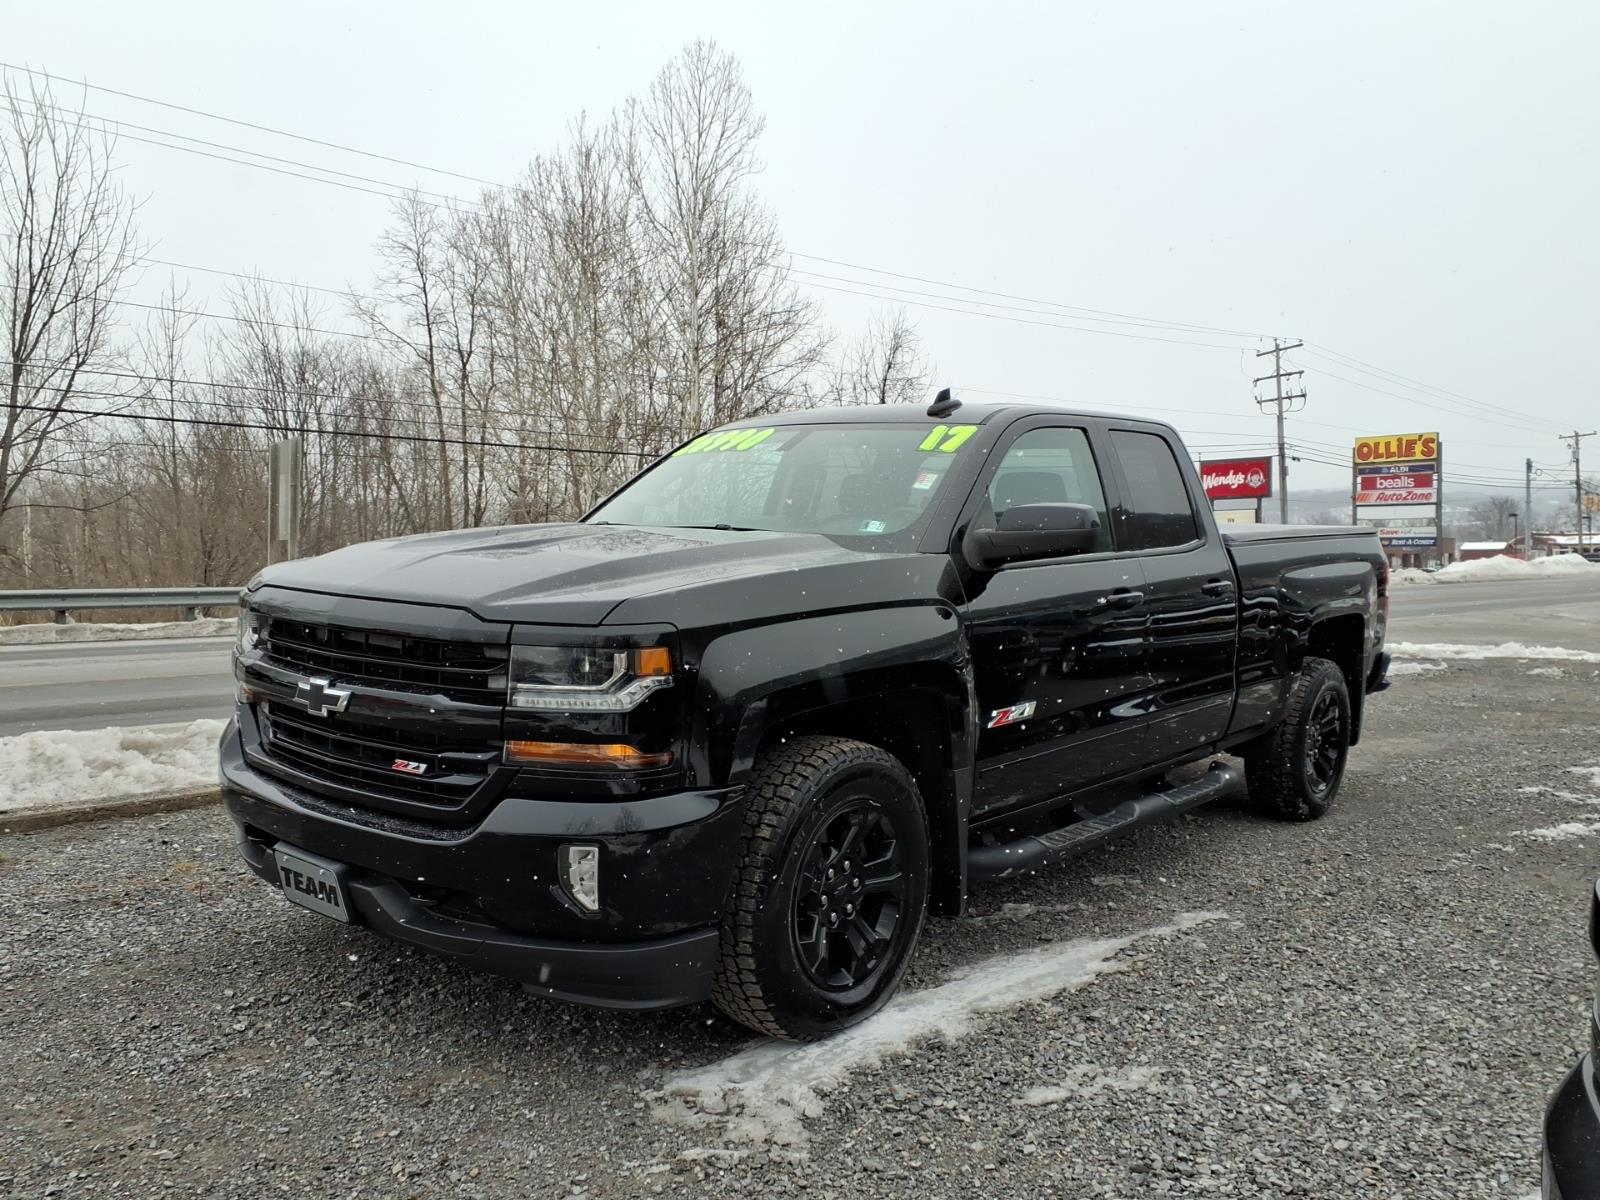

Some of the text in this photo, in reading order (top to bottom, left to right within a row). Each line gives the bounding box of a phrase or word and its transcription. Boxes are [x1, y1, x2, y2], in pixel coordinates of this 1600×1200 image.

[918, 425, 978, 452] 17
[1203, 470, 1245, 490] Wendy's
[1376, 476, 1415, 489] bealls
[1375, 490, 1433, 502] AutoZone
[987, 701, 1037, 729] Z71
[392, 759, 428, 775] Z71
[280, 866, 340, 907] TEAM
